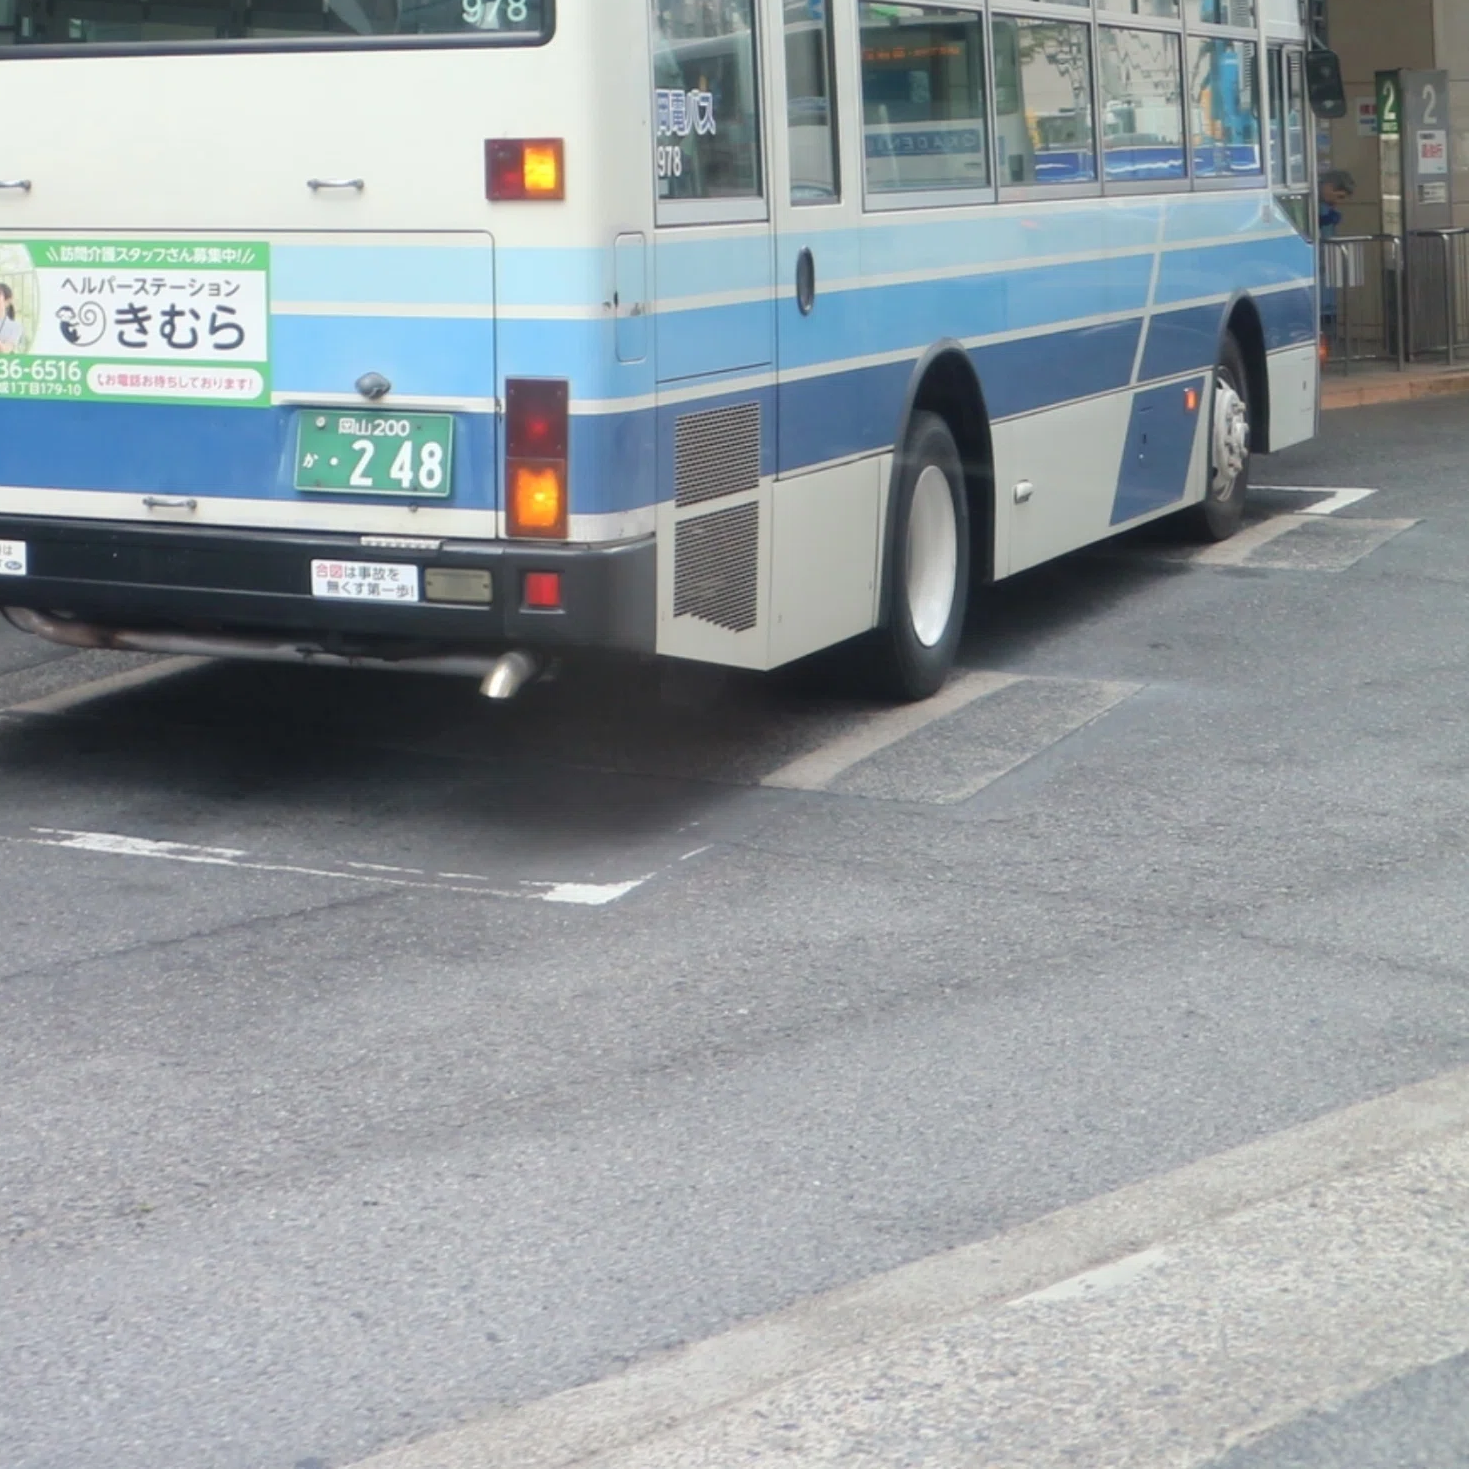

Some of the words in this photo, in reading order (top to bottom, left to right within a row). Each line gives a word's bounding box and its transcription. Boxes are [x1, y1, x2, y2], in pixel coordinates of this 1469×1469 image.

[1382, 80, 1397, 120] 2
[1421, 84, 1438, 125] 2
[657, 145, 682, 177] 978
[61, 277, 241, 298] ヘルパーステーション
[115, 302, 245, 350] きむら
[316, 563, 401, 581] 合図は事故を
